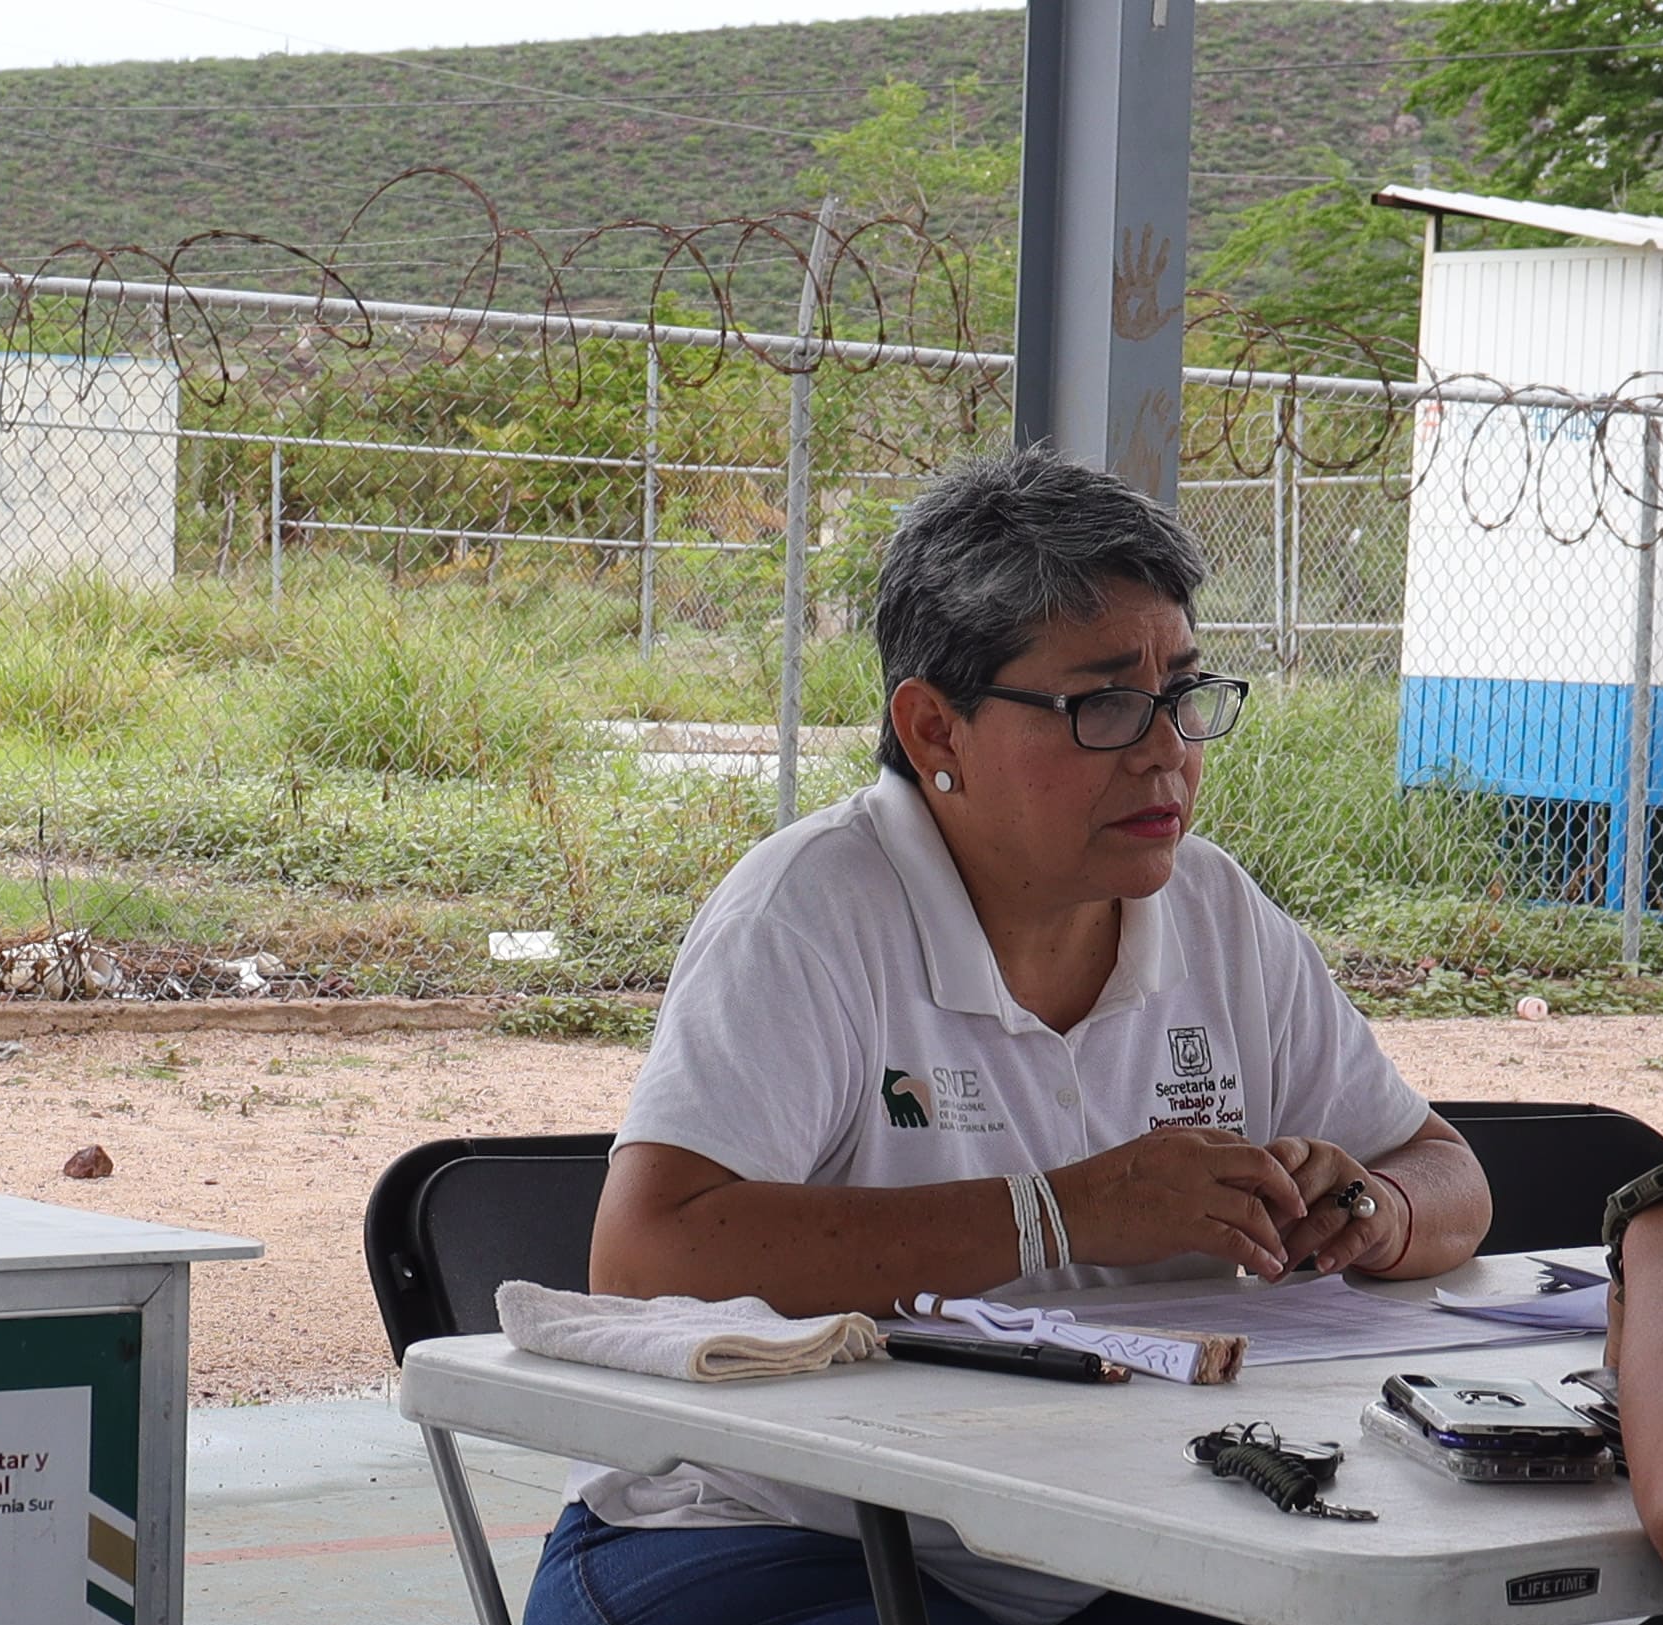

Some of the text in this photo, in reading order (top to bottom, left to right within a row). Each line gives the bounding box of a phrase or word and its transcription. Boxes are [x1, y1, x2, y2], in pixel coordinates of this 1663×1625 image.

[1220, 1074, 1237, 1090] del
[1168, 1094, 1226, 1112] Trabajo y
[1149, 1110, 1212, 1131] Desarrollo
[35, 1452, 49, 1472] y
[28, 1498, 55, 1512] Sur
[1518, 1575, 1588, 1598] LIFETIME
